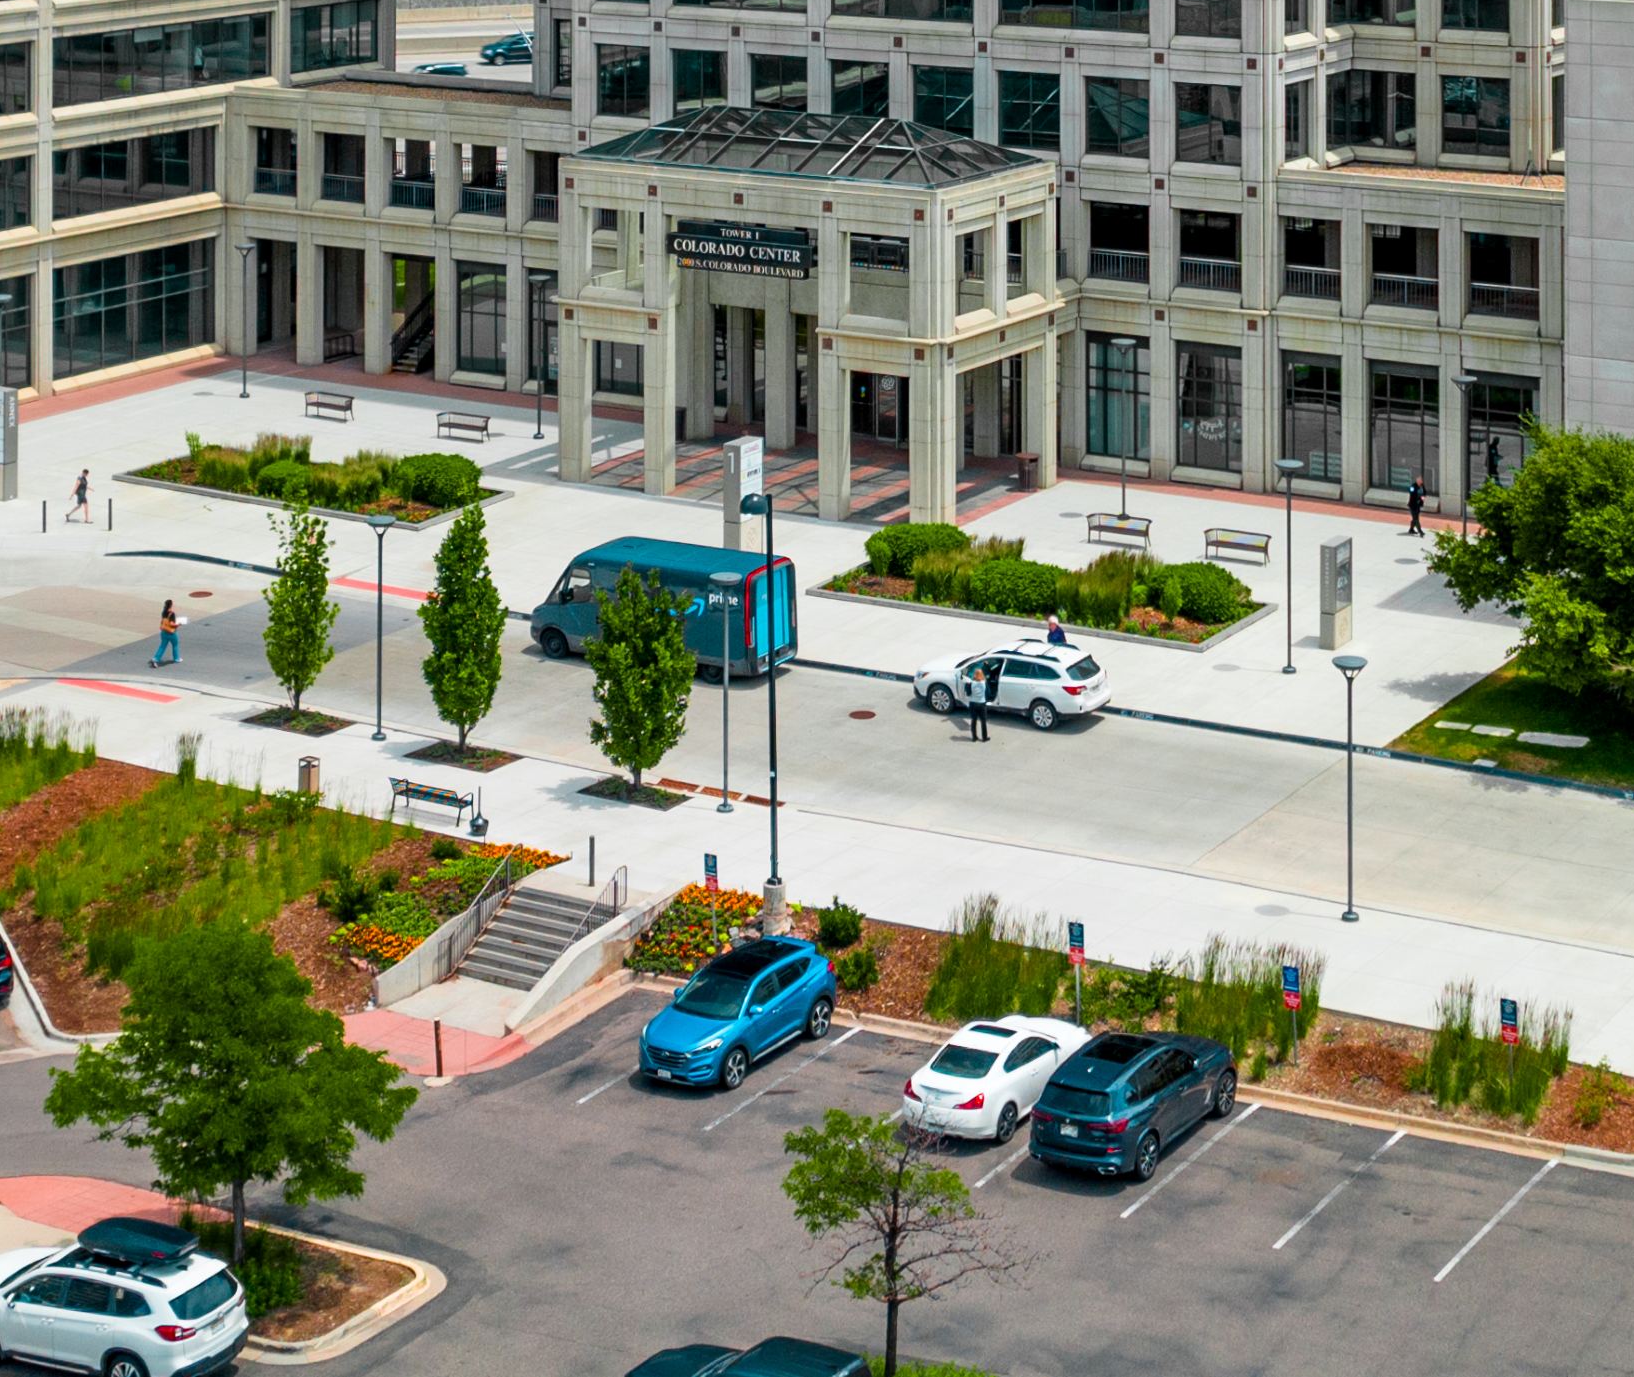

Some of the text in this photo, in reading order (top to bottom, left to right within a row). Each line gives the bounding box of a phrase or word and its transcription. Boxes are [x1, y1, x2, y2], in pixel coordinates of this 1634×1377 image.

[720, 228, 752, 239] TOWER
[673, 238, 801, 263] COLORADO CENTER
[703, 261, 752, 274] COLORADO
[753, 265, 804, 279] BOULEVARD
[727, 452, 735, 474] 1
